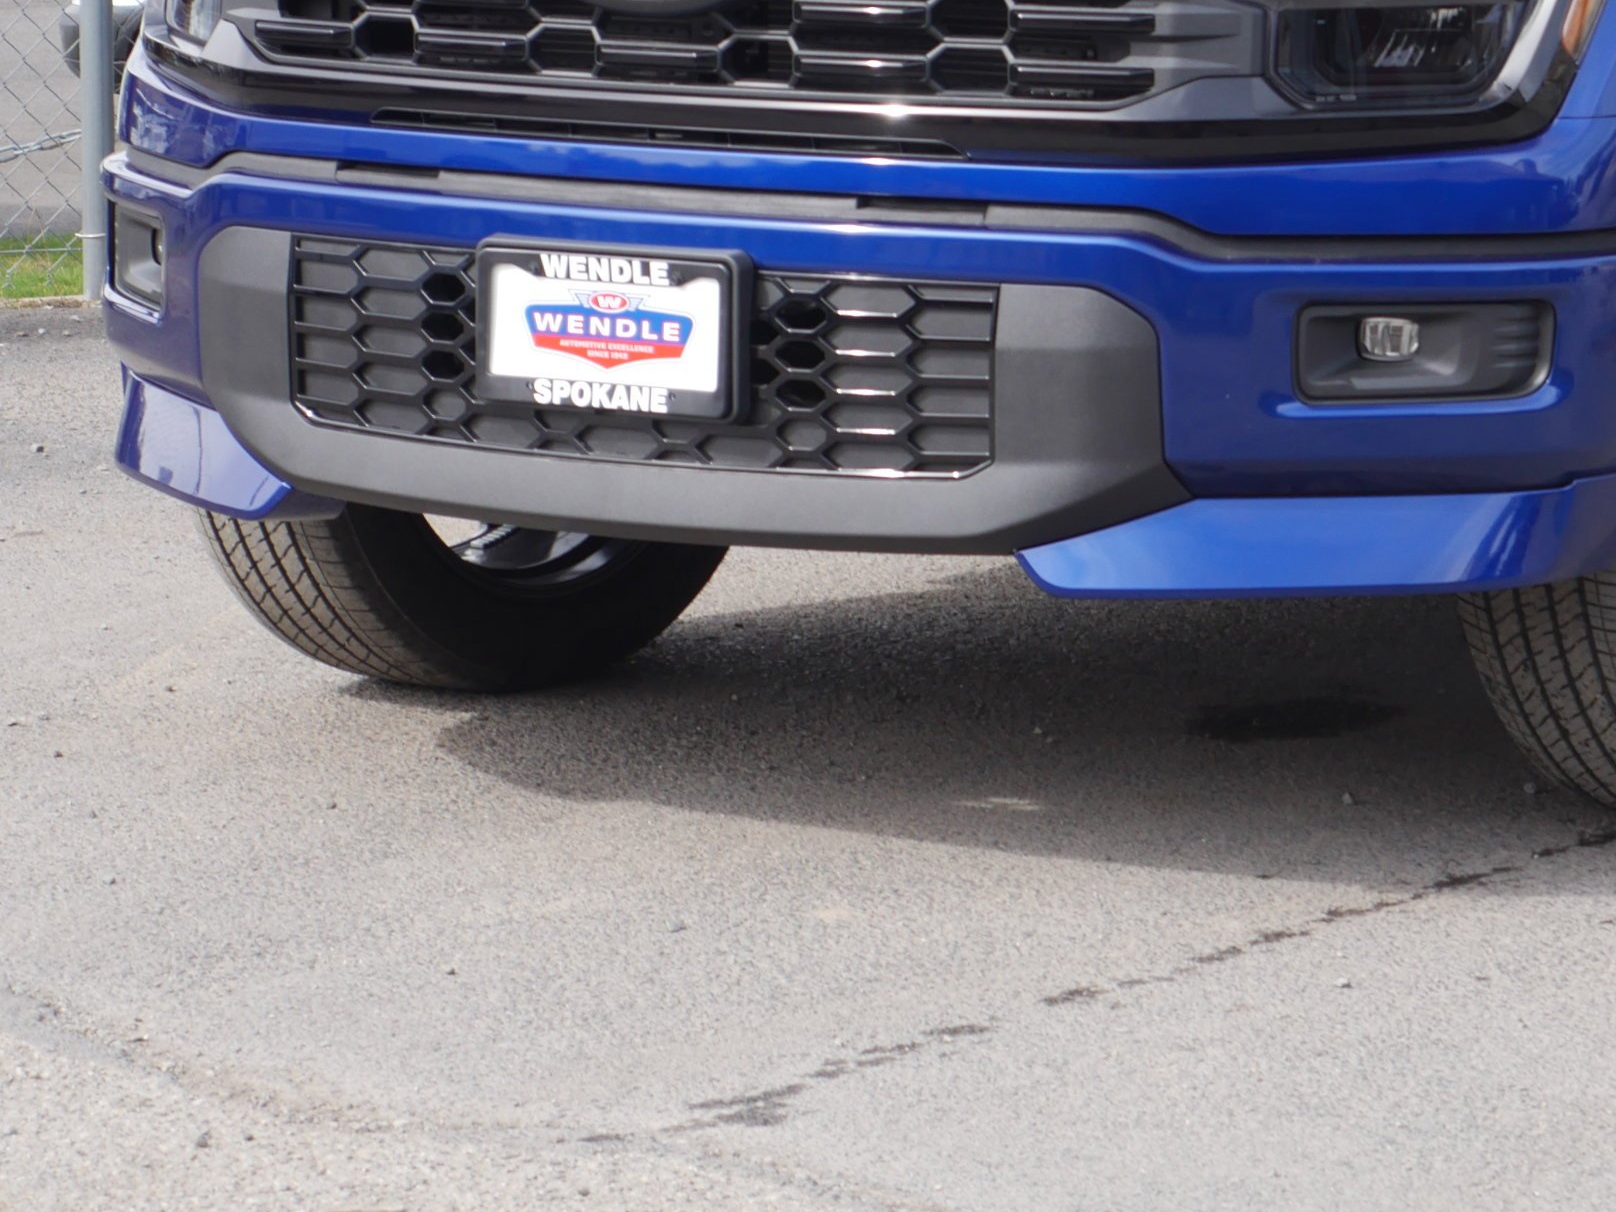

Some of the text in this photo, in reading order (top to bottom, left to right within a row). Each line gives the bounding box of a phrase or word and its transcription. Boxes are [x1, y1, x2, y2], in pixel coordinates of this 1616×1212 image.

[539, 253, 670, 286] WENDLE
[596, 295, 622, 309] W
[532, 311, 681, 342] WENDLE
[533, 378, 669, 413] SPOKANE
